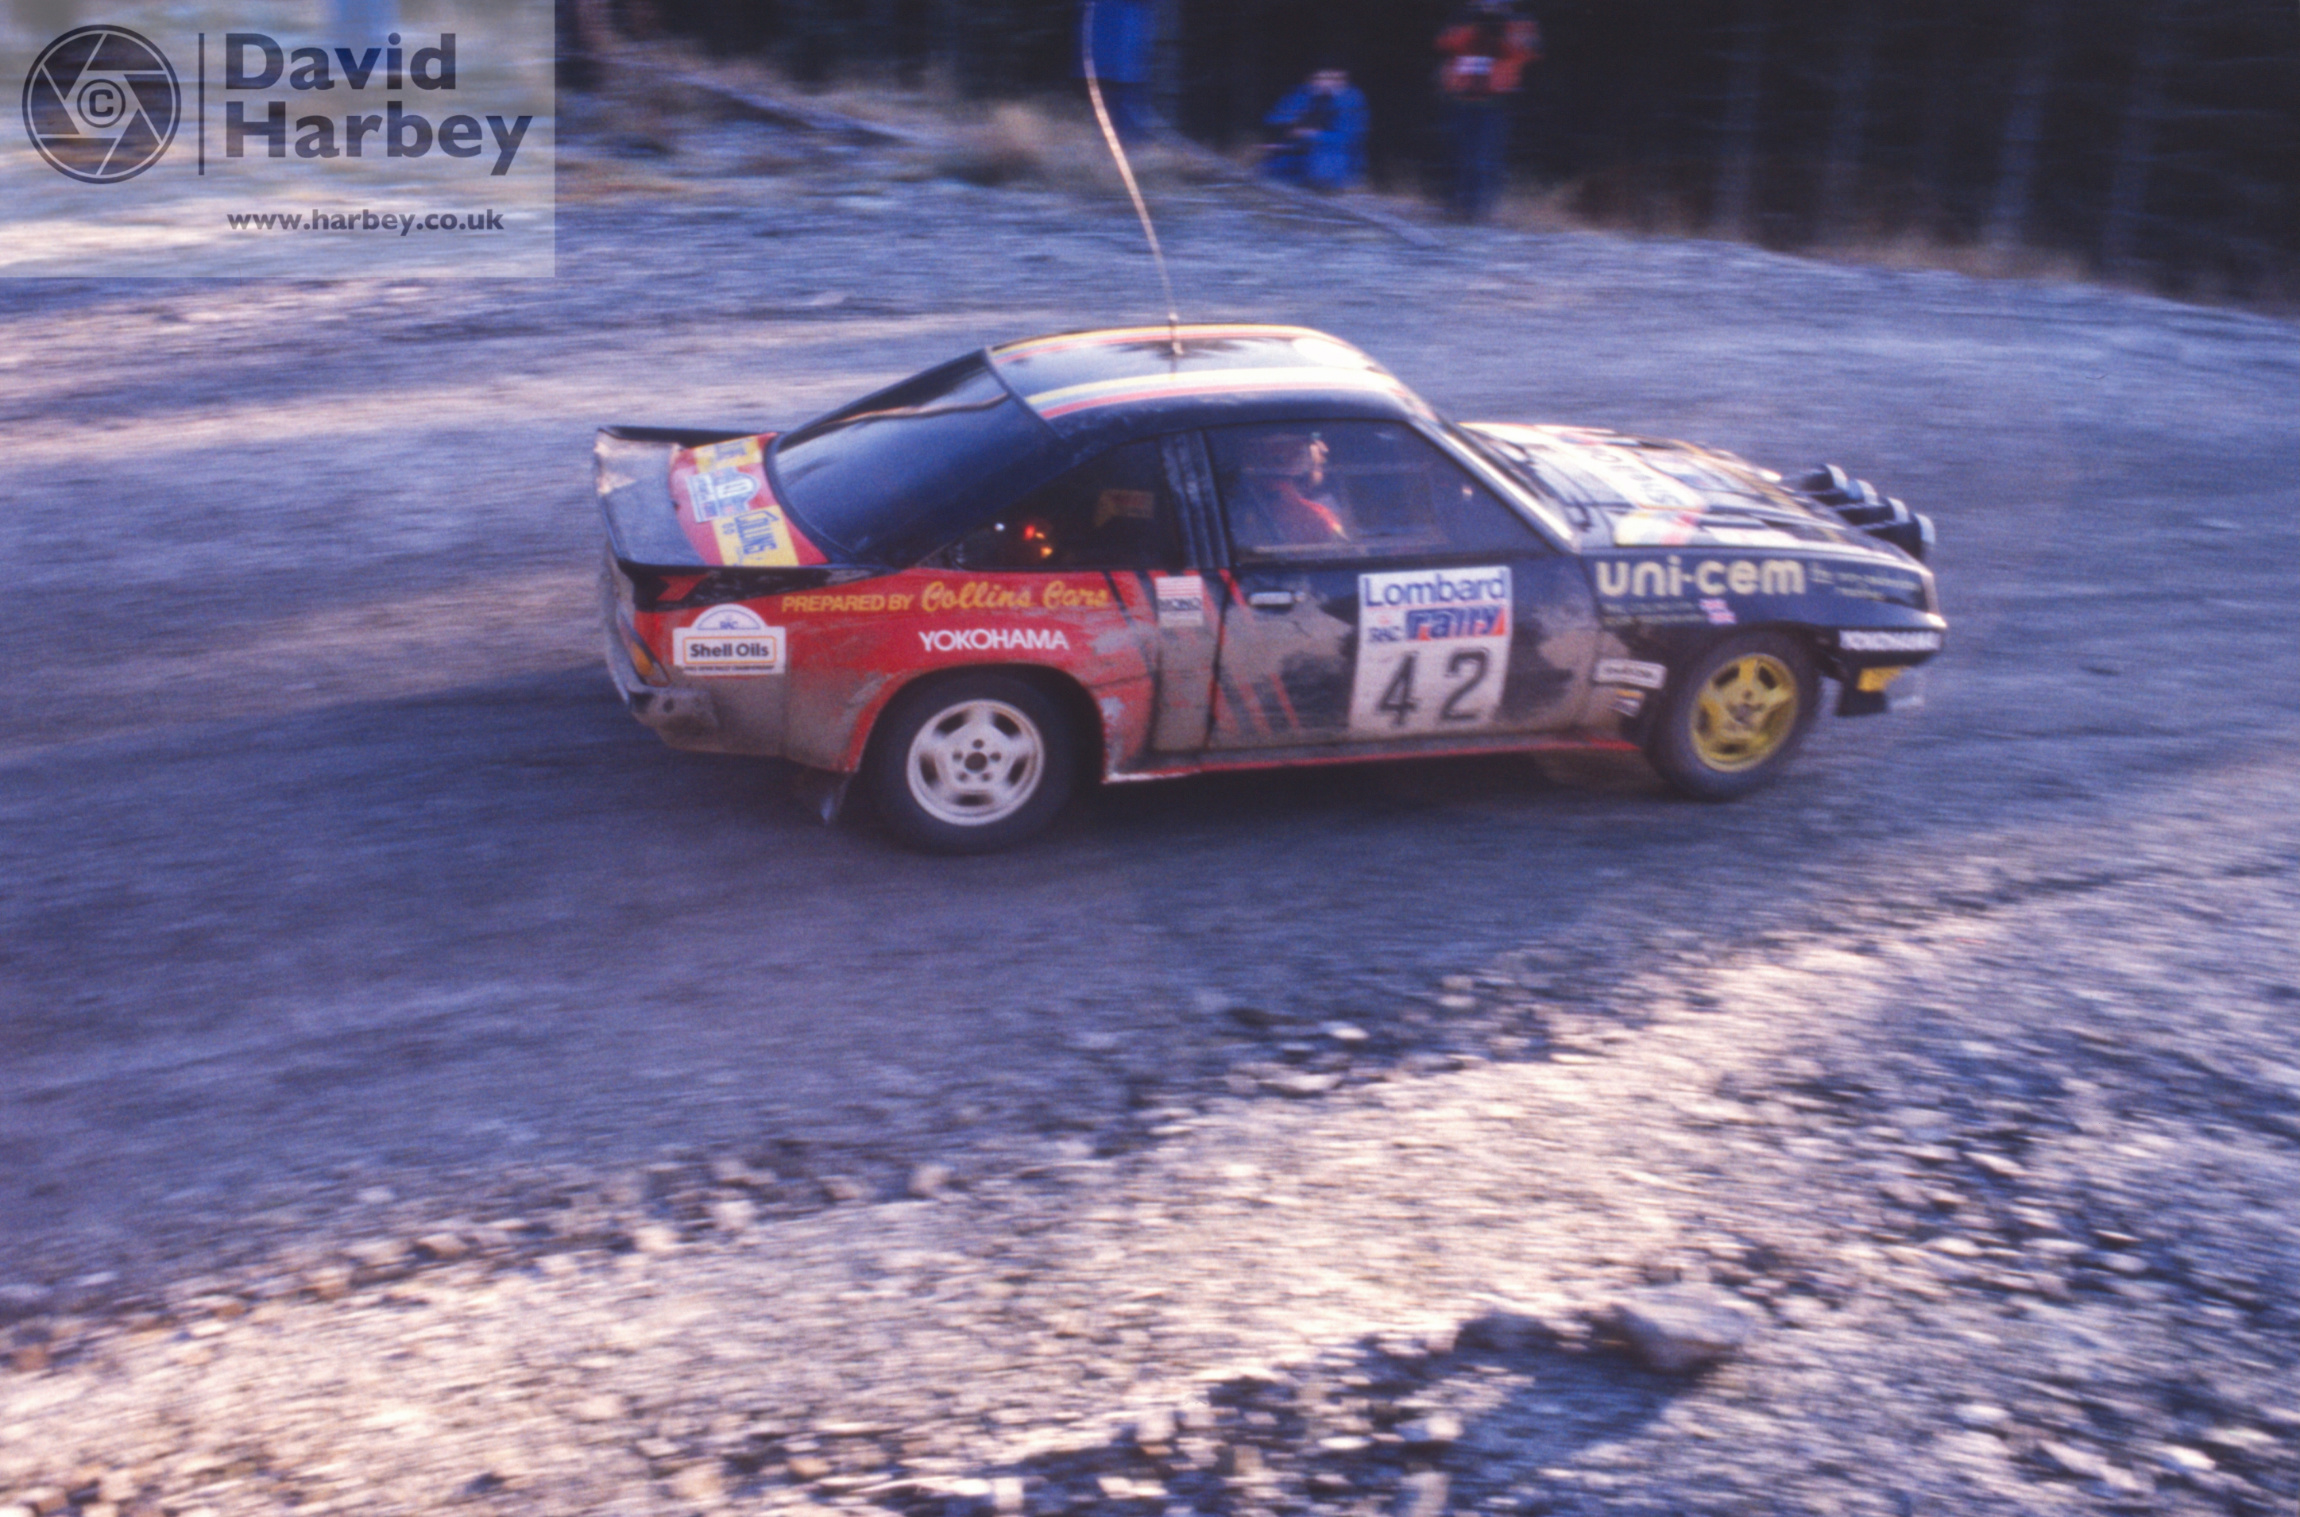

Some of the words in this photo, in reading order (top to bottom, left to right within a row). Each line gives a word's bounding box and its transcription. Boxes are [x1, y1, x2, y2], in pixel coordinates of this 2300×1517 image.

[1364, 569, 1508, 607] Lombard
[1596, 555, 1806, 597] uni-cem
[781, 594, 885, 612] PREPARED
[887, 593, 915, 611] BY
[921, 581, 1035, 612] Collins
[1043, 580, 1109, 609] Cars
[690, 643, 732, 657] Shell
[736, 643, 769, 657] Oils
[918, 629, 1070, 652] YOKOHAMA
[1373, 647, 1490, 725] 42
